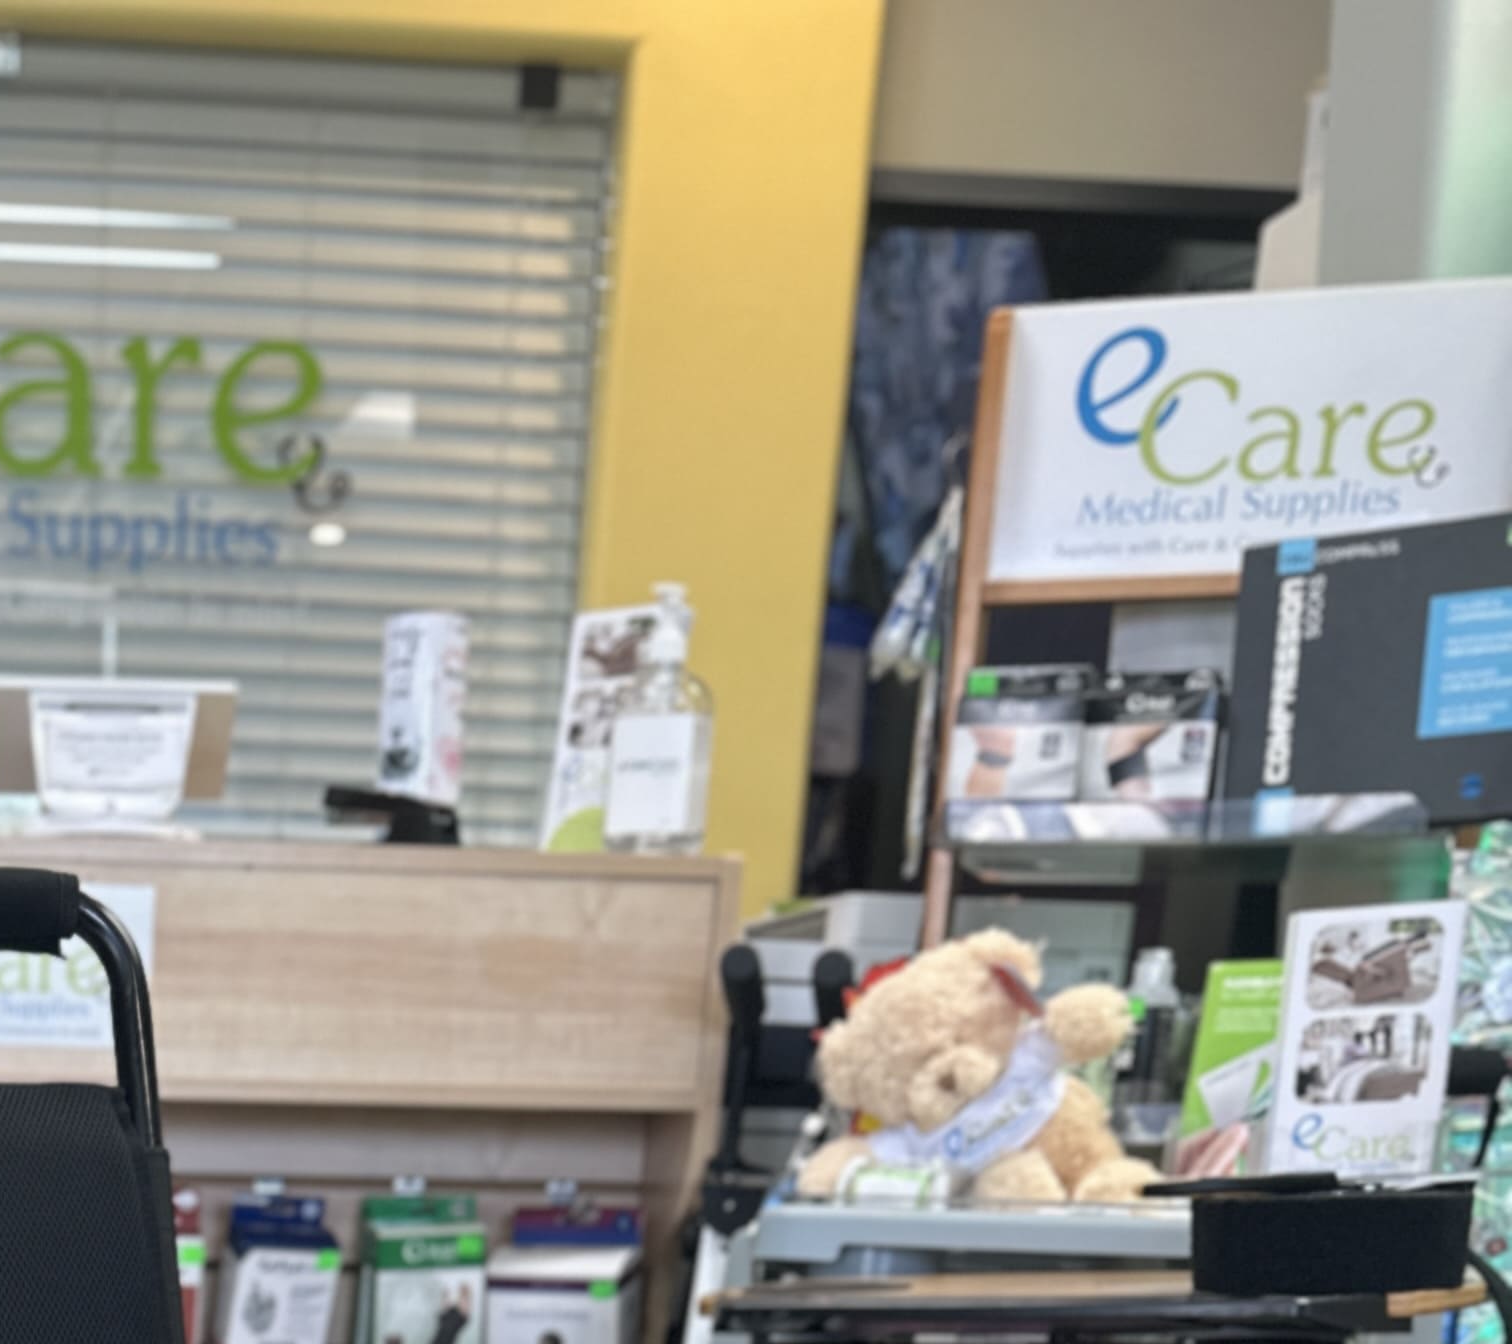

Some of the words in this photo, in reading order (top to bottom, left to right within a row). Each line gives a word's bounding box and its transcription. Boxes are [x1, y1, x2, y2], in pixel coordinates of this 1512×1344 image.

[1074, 325, 1438, 487] eCare
[7, 490, 281, 566] Supplies
[1075, 485, 1228, 528] Medical
[1240, 479, 1402, 528] Supplies
[1291, 1112, 1412, 1163] eCare
